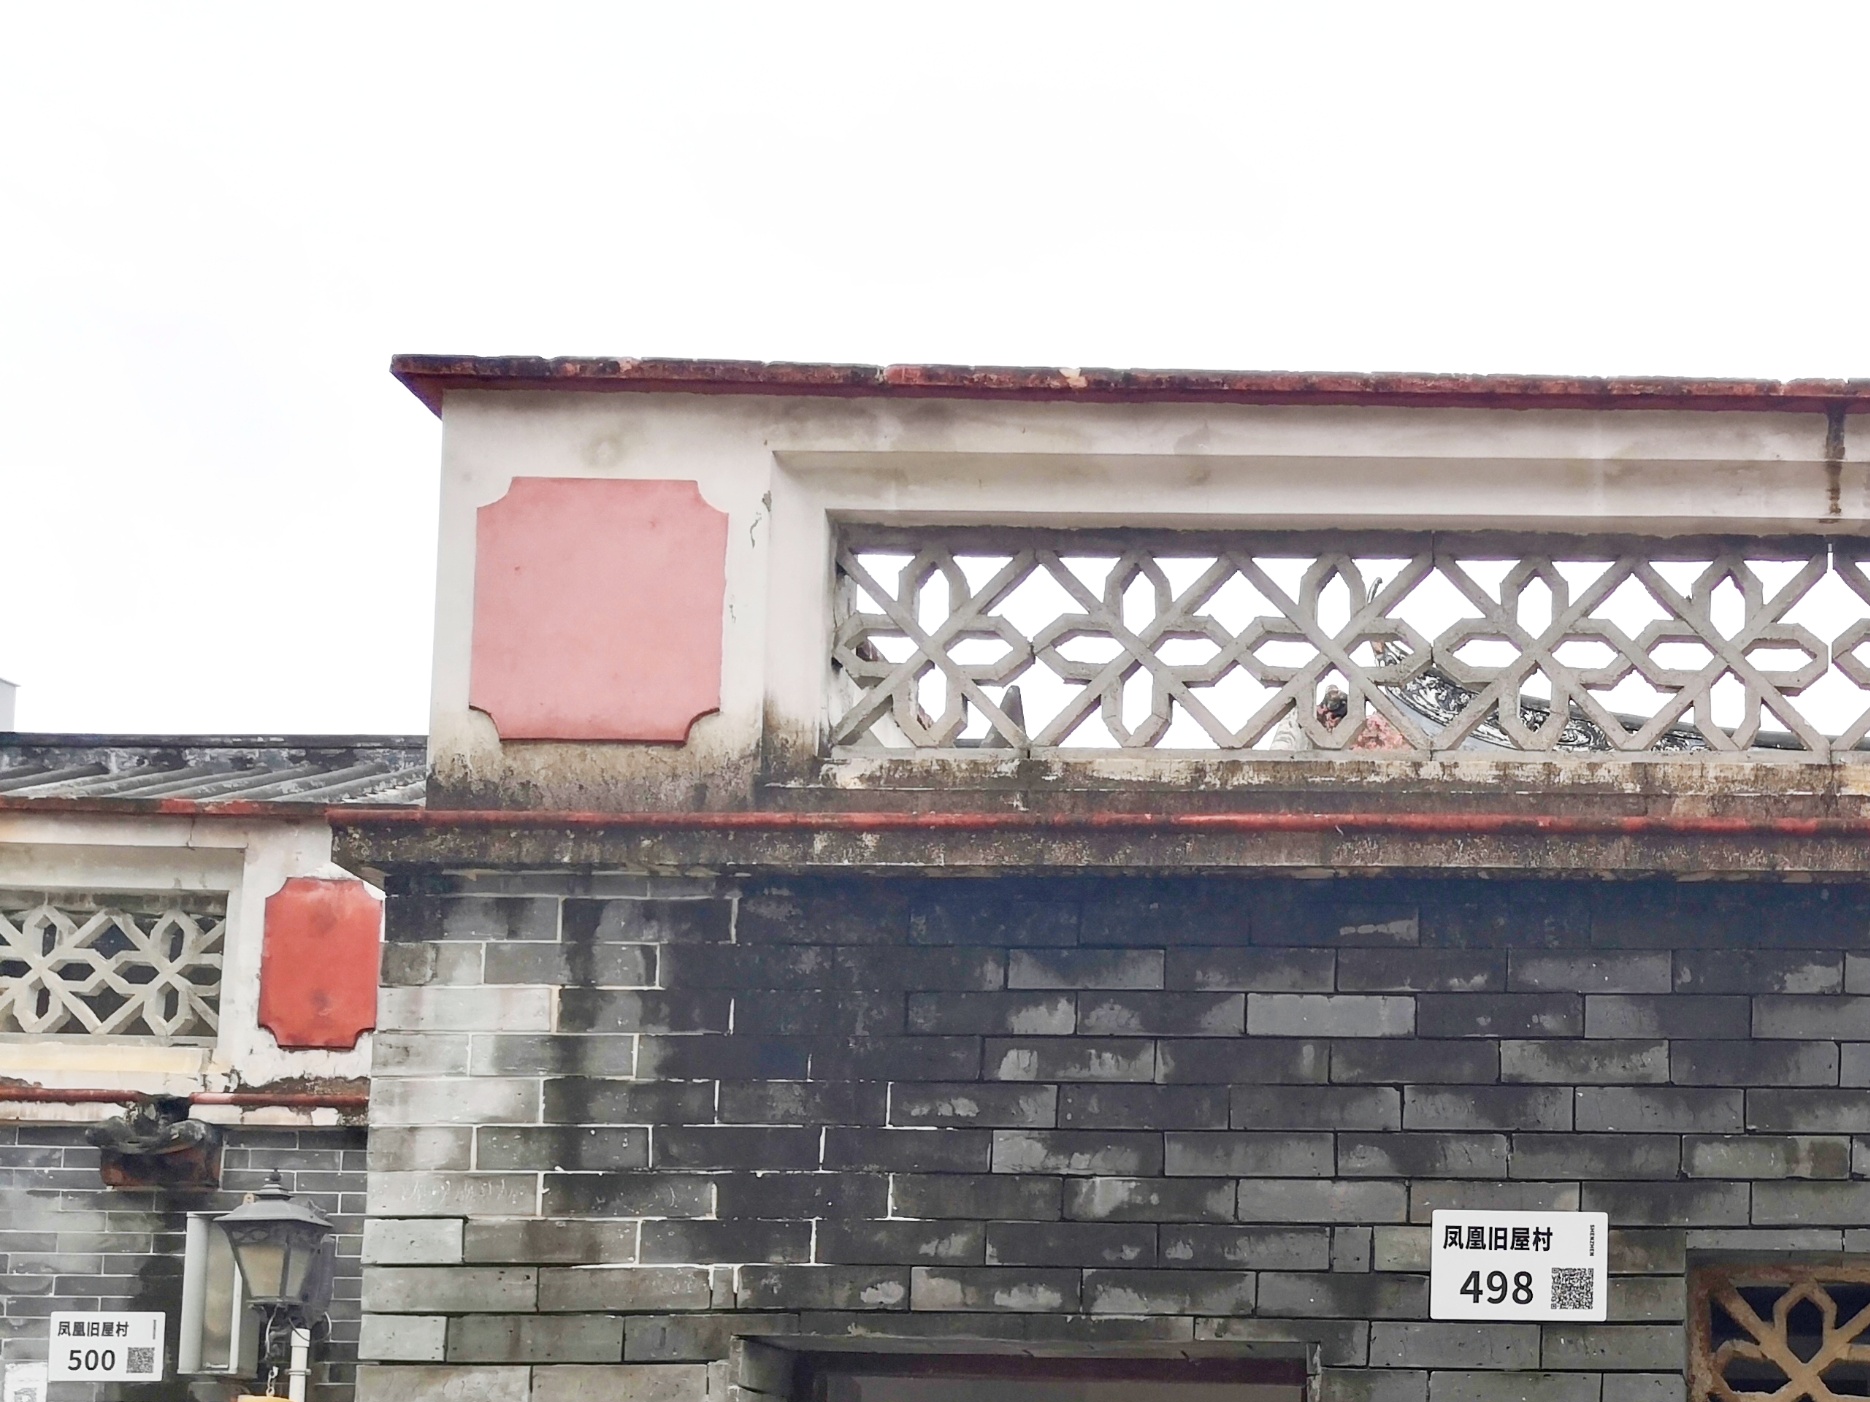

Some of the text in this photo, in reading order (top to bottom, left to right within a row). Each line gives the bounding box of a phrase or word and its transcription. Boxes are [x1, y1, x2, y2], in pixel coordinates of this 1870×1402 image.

[1443, 1225, 1553, 1252] 凤凰旧屋村
[1459, 1270, 1534, 1305] 498
[57, 1321, 129, 1337] 凤凰旧屋村
[67, 1349, 116, 1371] 500
